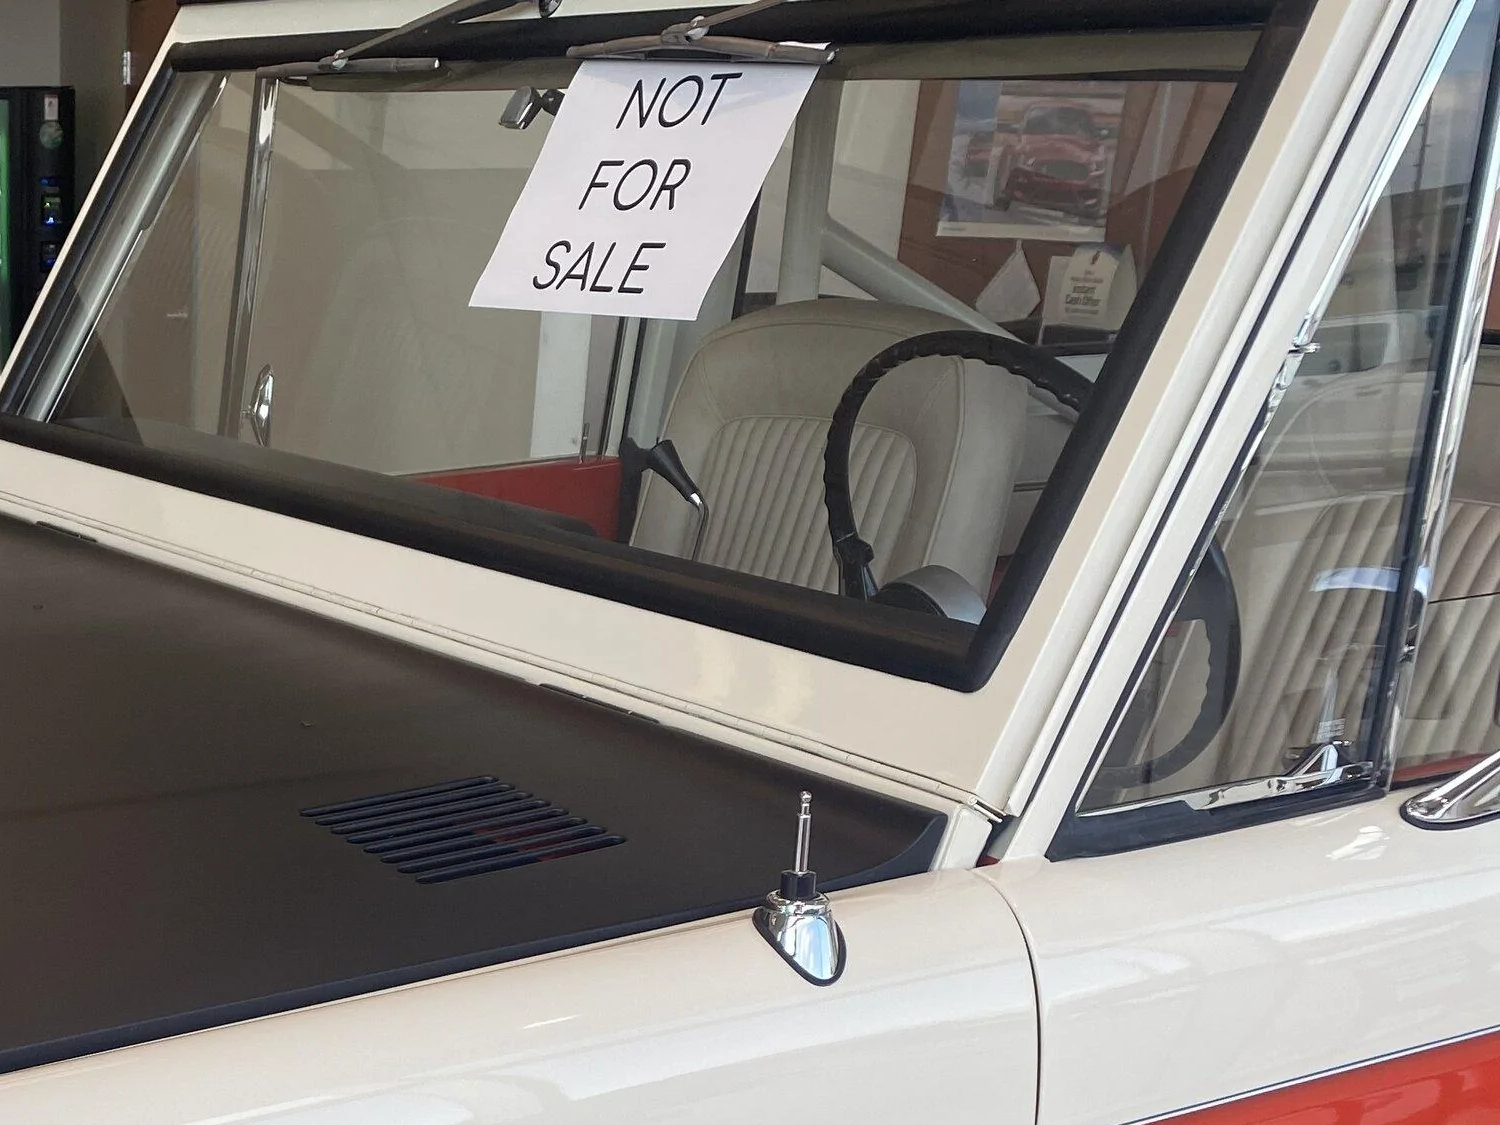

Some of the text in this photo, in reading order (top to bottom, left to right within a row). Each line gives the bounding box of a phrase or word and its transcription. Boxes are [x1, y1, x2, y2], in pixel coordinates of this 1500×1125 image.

[615, 72, 742, 130] NOT
[578, 158, 691, 211] FOR
[532, 240, 666, 294] SALE
